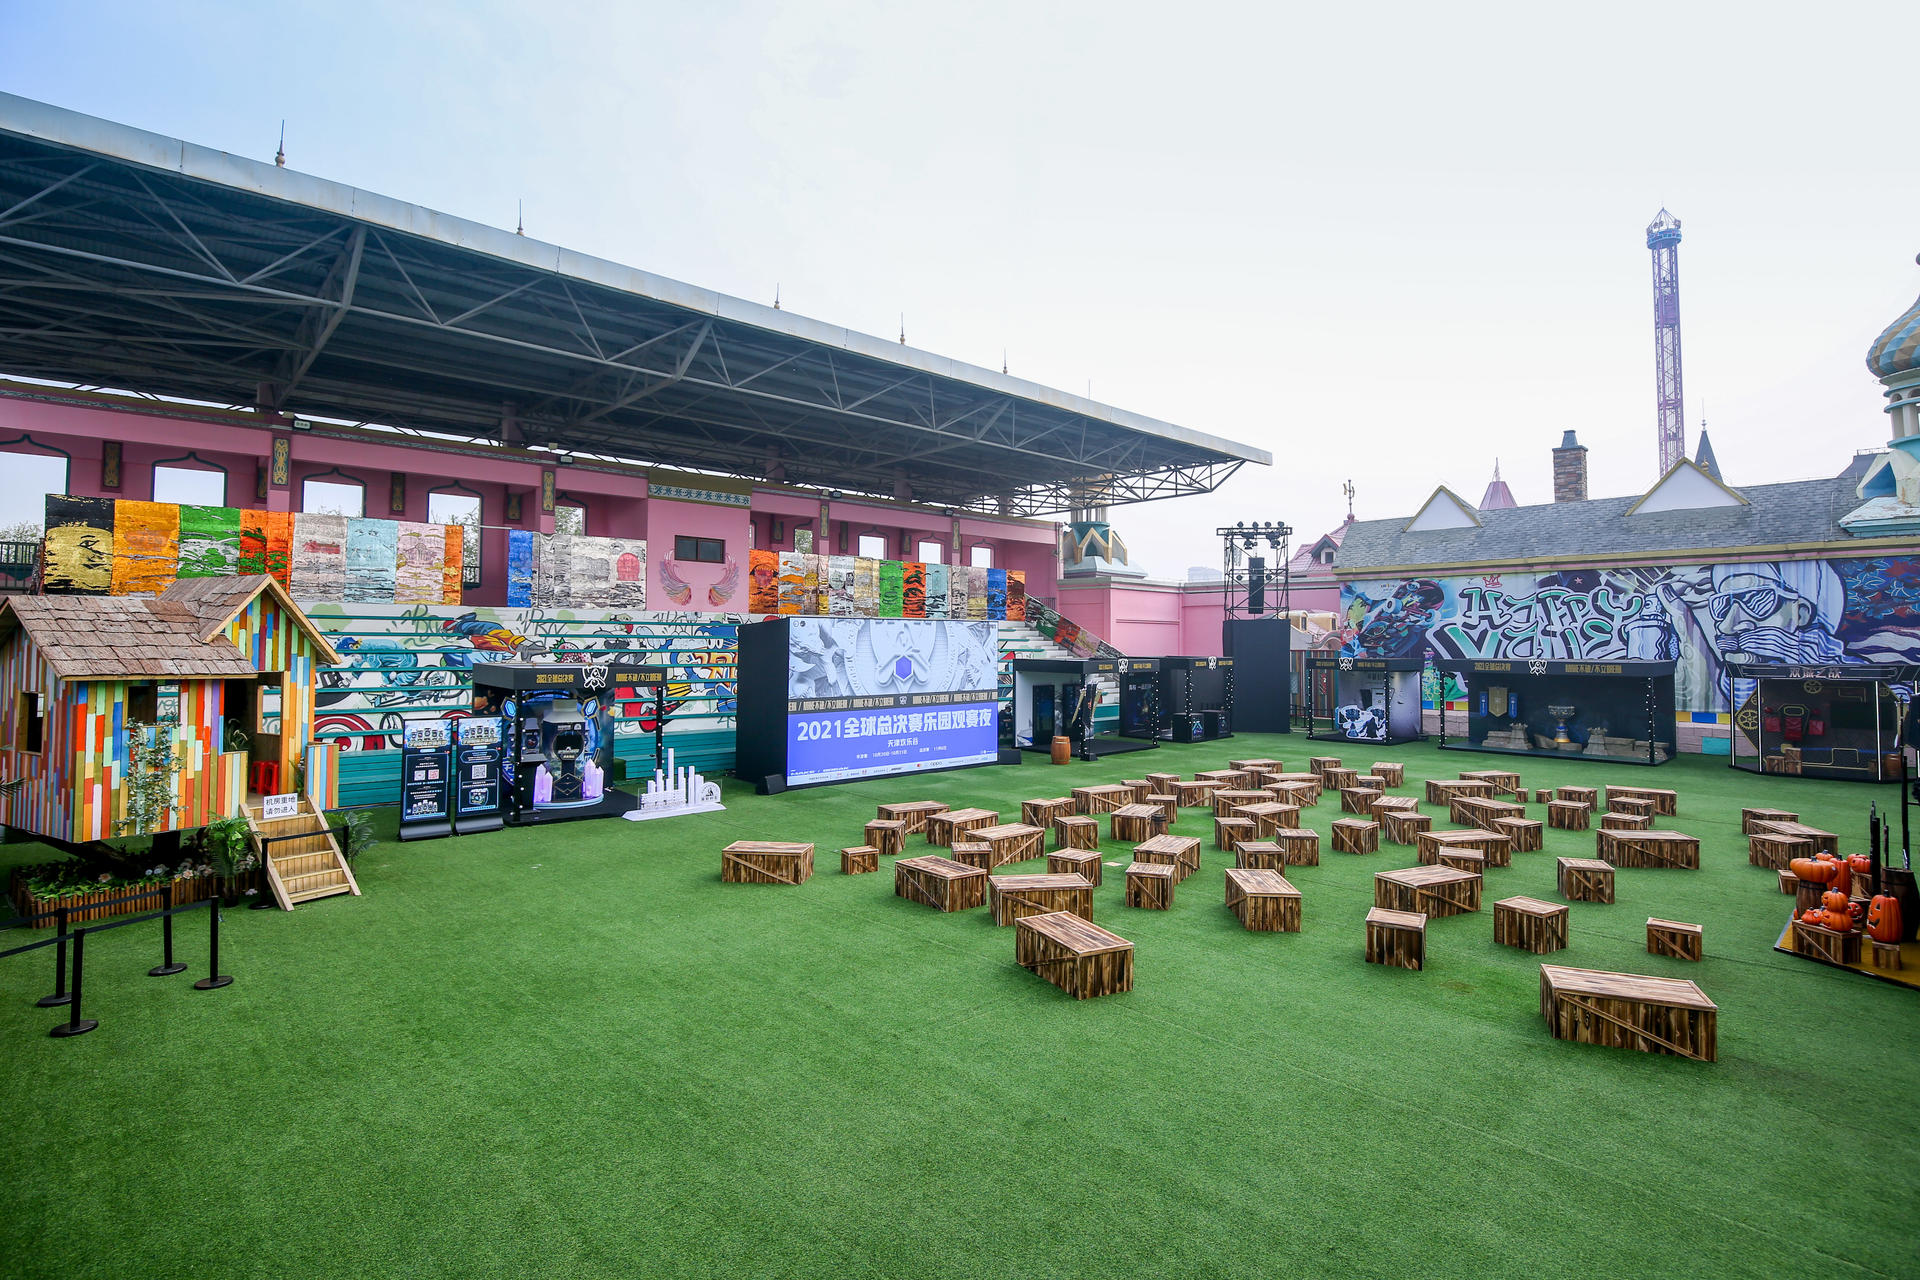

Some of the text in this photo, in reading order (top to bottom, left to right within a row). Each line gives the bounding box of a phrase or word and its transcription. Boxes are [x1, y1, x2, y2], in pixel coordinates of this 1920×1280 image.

[797, 708, 992, 741] 2021全球总决赛乐园观赛夜
[887, 737, 919, 748] 天津欢乐谷
